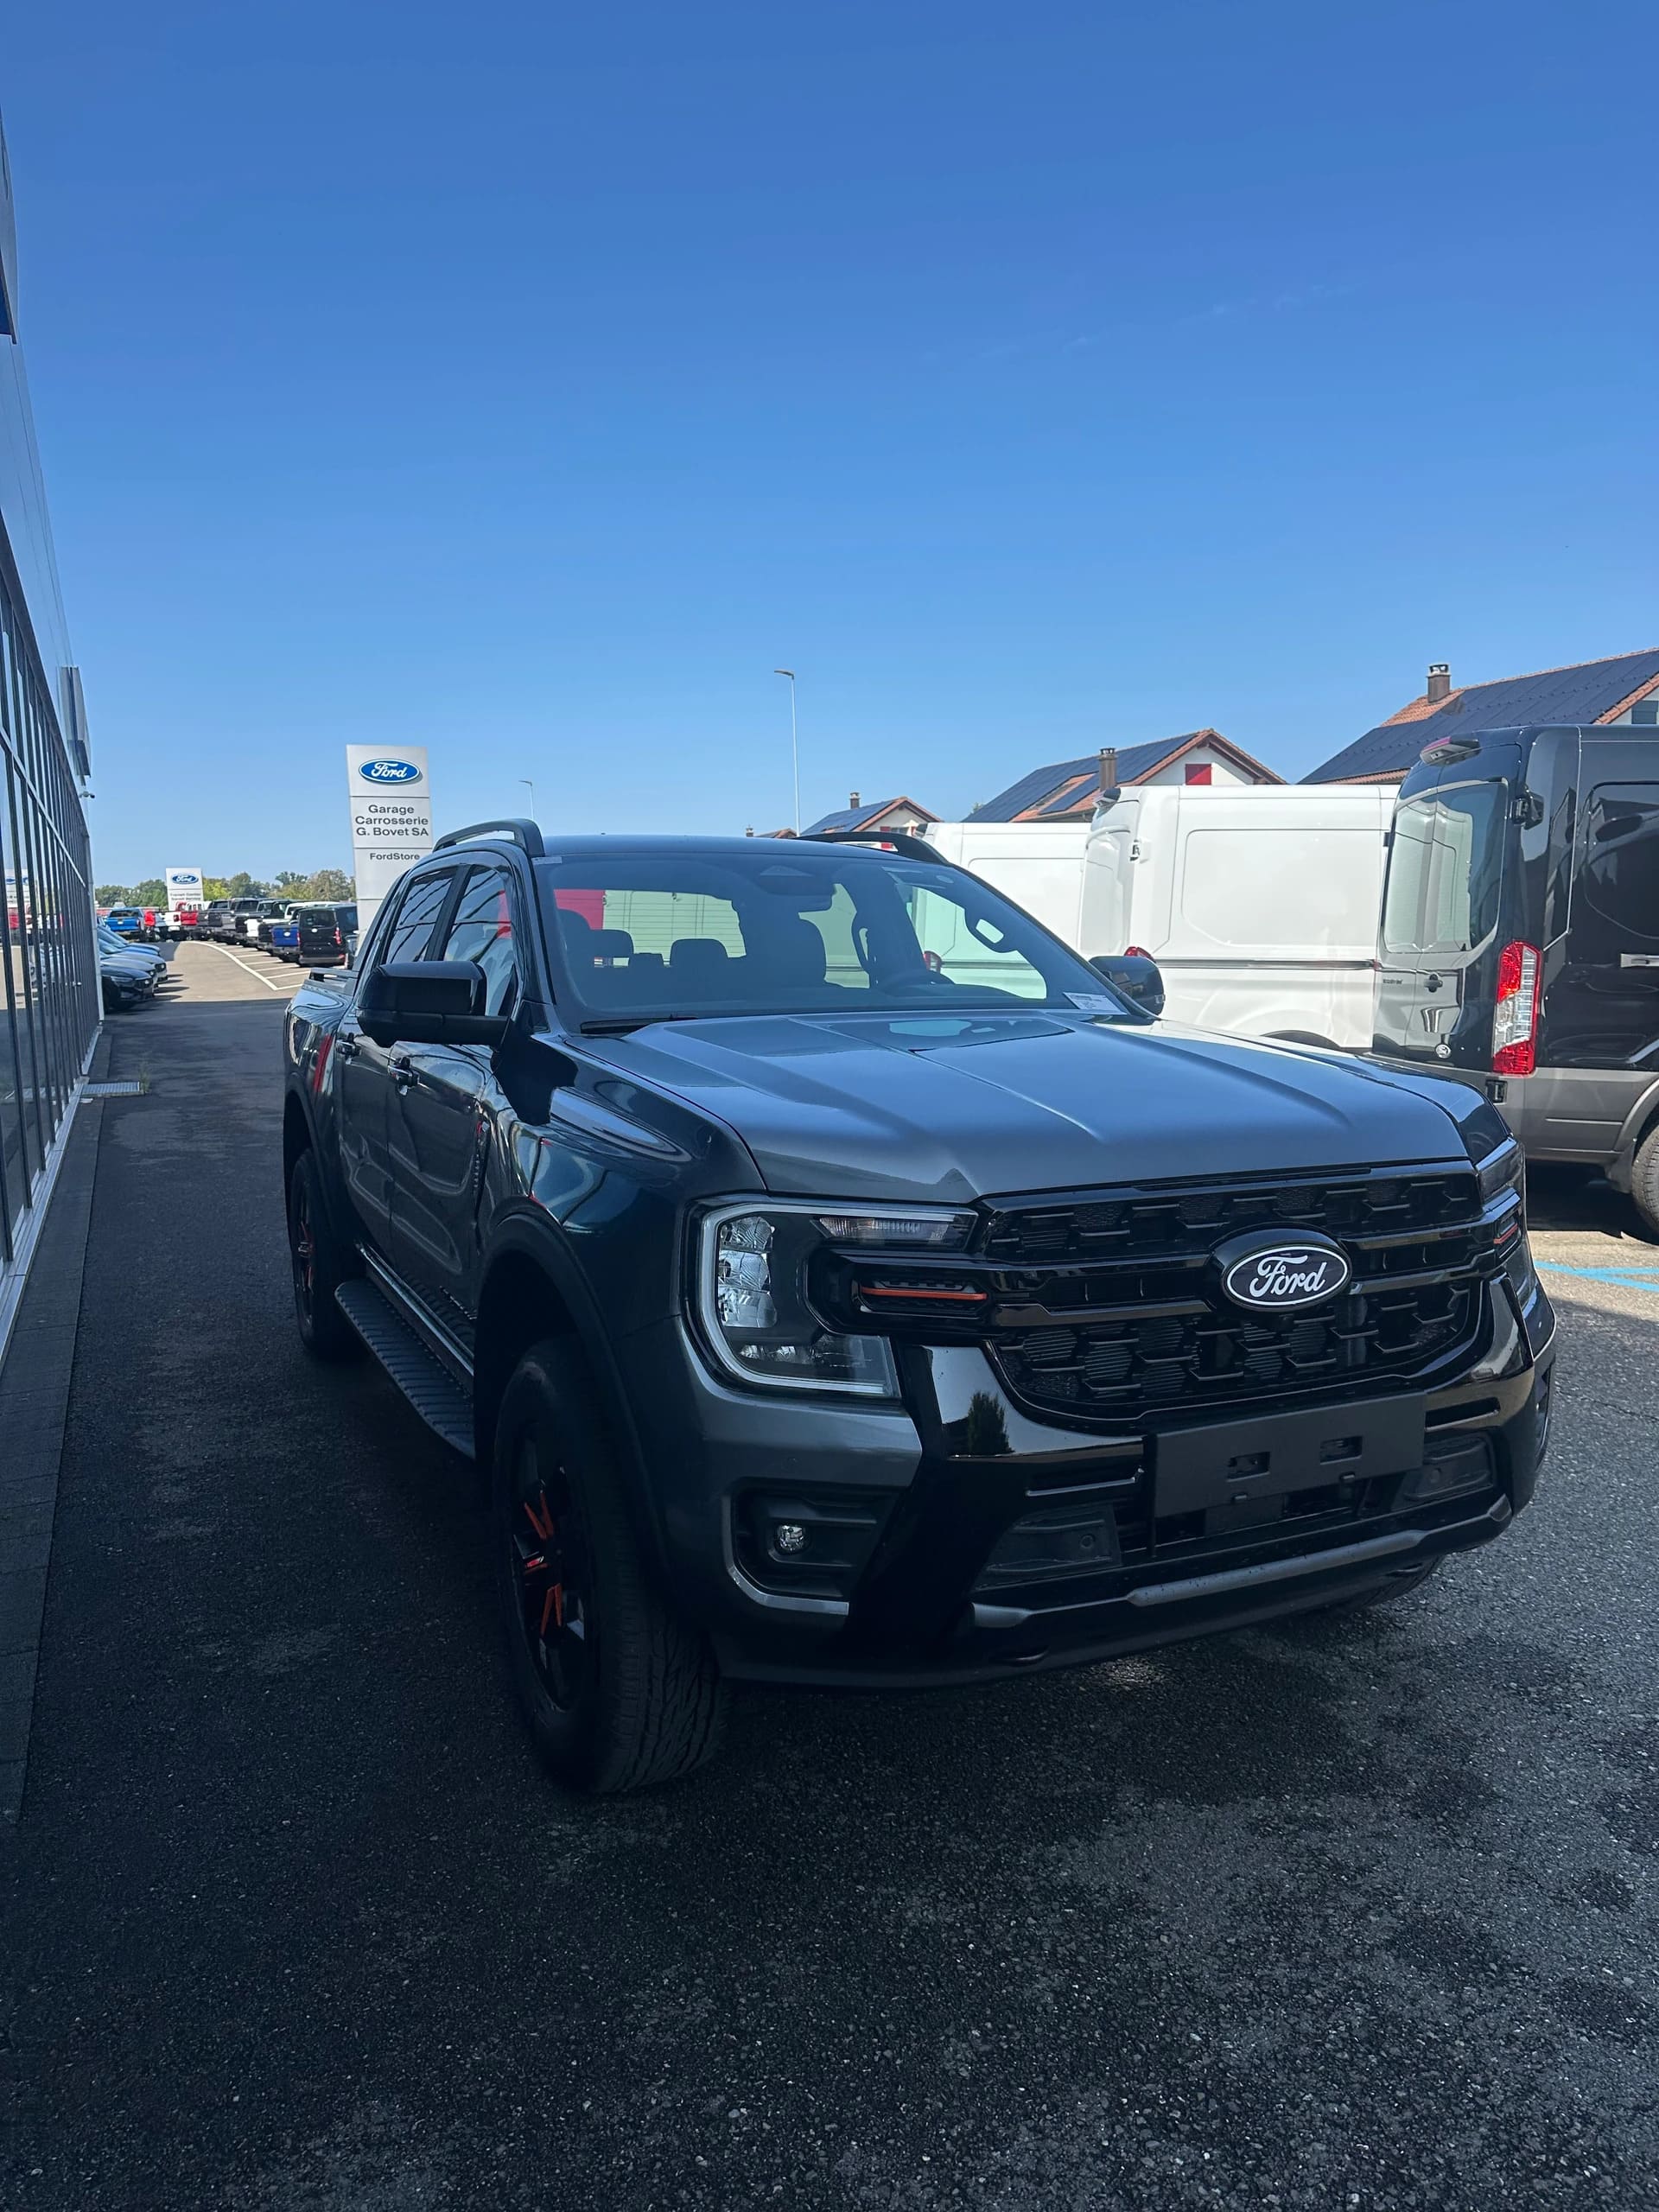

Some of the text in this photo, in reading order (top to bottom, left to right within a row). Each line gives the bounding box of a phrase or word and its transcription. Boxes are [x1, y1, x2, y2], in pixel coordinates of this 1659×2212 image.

[372, 762, 407, 778] Ford
[368, 804, 414, 815] Garage
[355, 816, 429, 825] Carrosserie
[356, 827, 429, 836] G. Bovet SA
[1249, 1255, 1326, 1297] Ford
